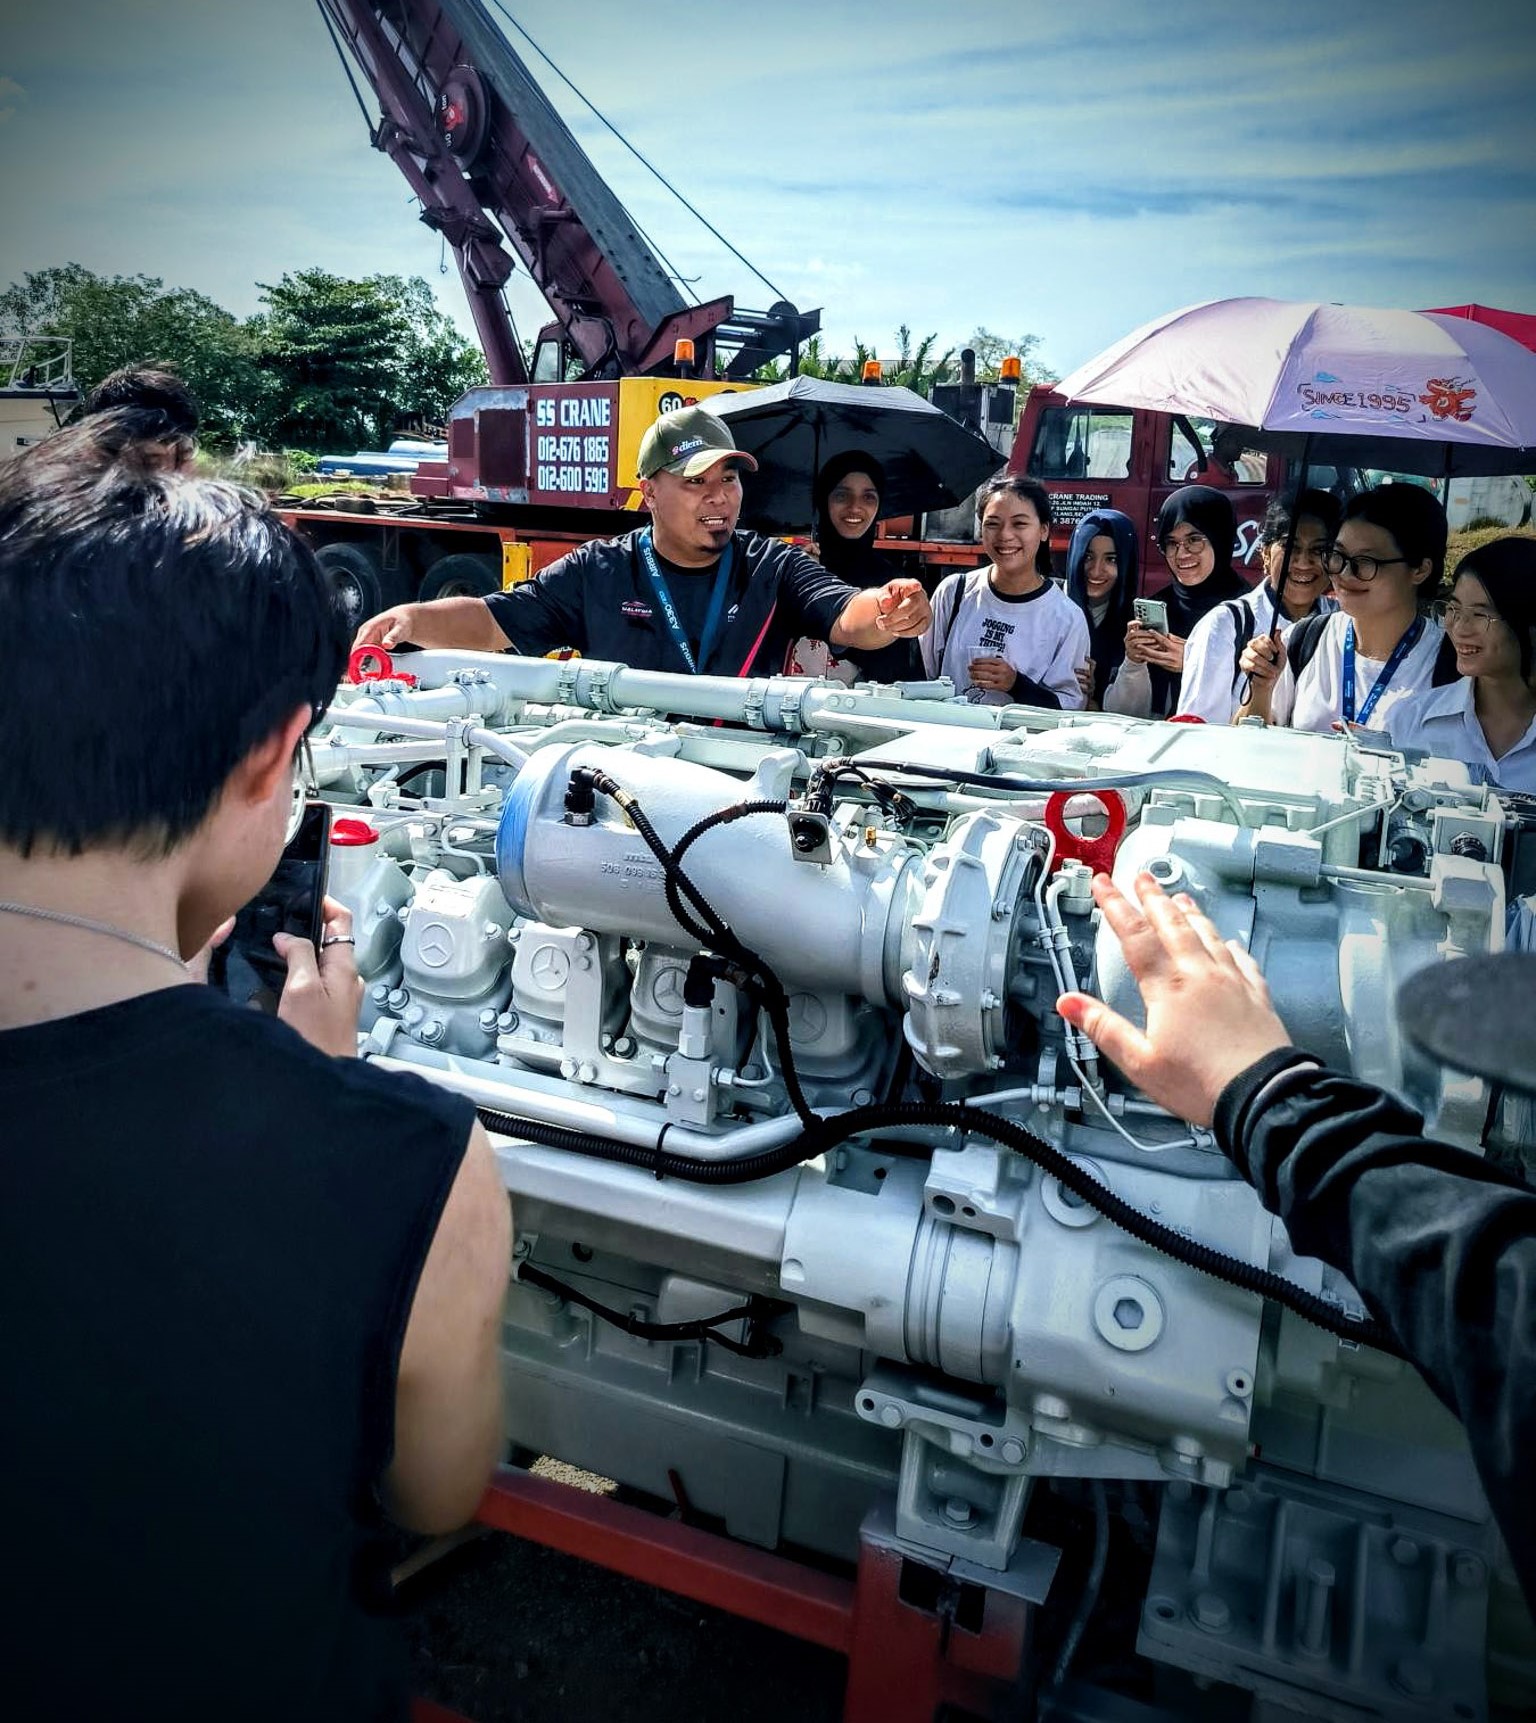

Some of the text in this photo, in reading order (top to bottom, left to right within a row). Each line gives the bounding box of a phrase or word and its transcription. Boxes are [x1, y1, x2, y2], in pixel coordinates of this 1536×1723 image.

[536, 398, 611, 427] SS CRANE
[537, 435, 610, 463] 012-676 1865
[537, 465, 609, 494] 012-600 5913
[1048, 493, 1109, 501] CRANE TRADING
[643, 547, 660, 577] AIRBUS
